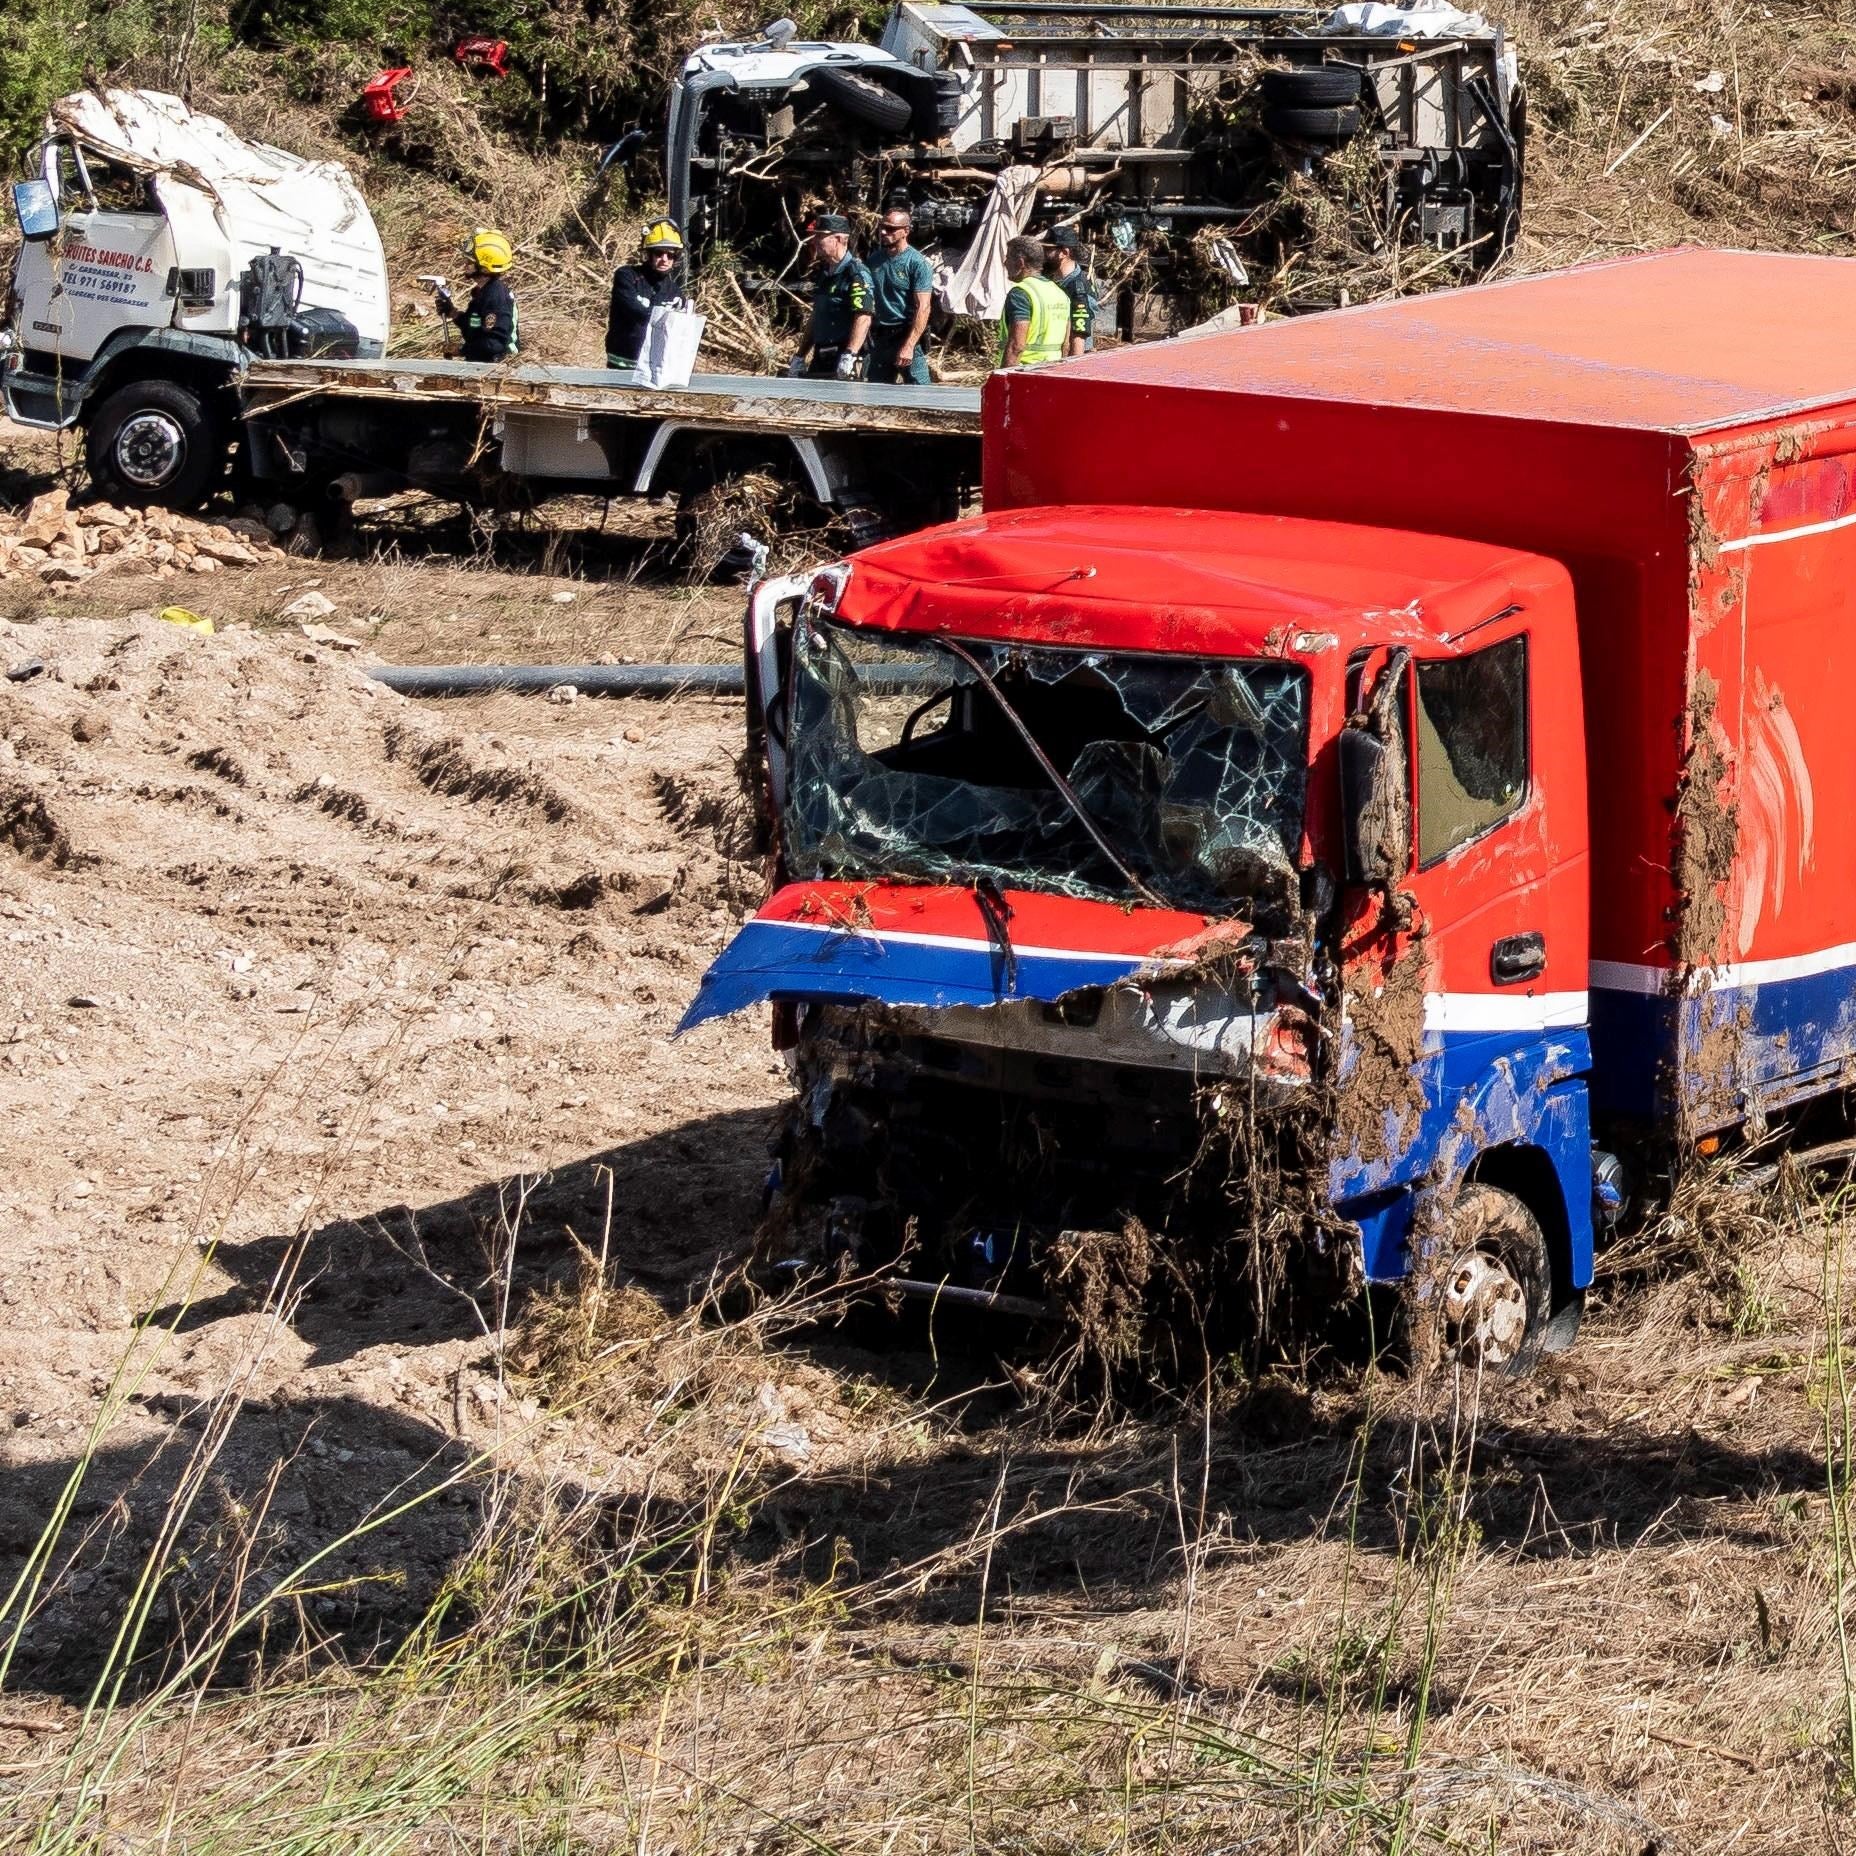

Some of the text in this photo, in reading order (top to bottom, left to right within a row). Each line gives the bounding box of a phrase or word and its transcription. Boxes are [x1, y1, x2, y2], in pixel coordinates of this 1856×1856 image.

[98, 249, 135, 270] SANCHO
[135, 256, 153, 273] C.B.
[62, 272, 77, 284] TEL
[80, 276, 97, 288] 971
